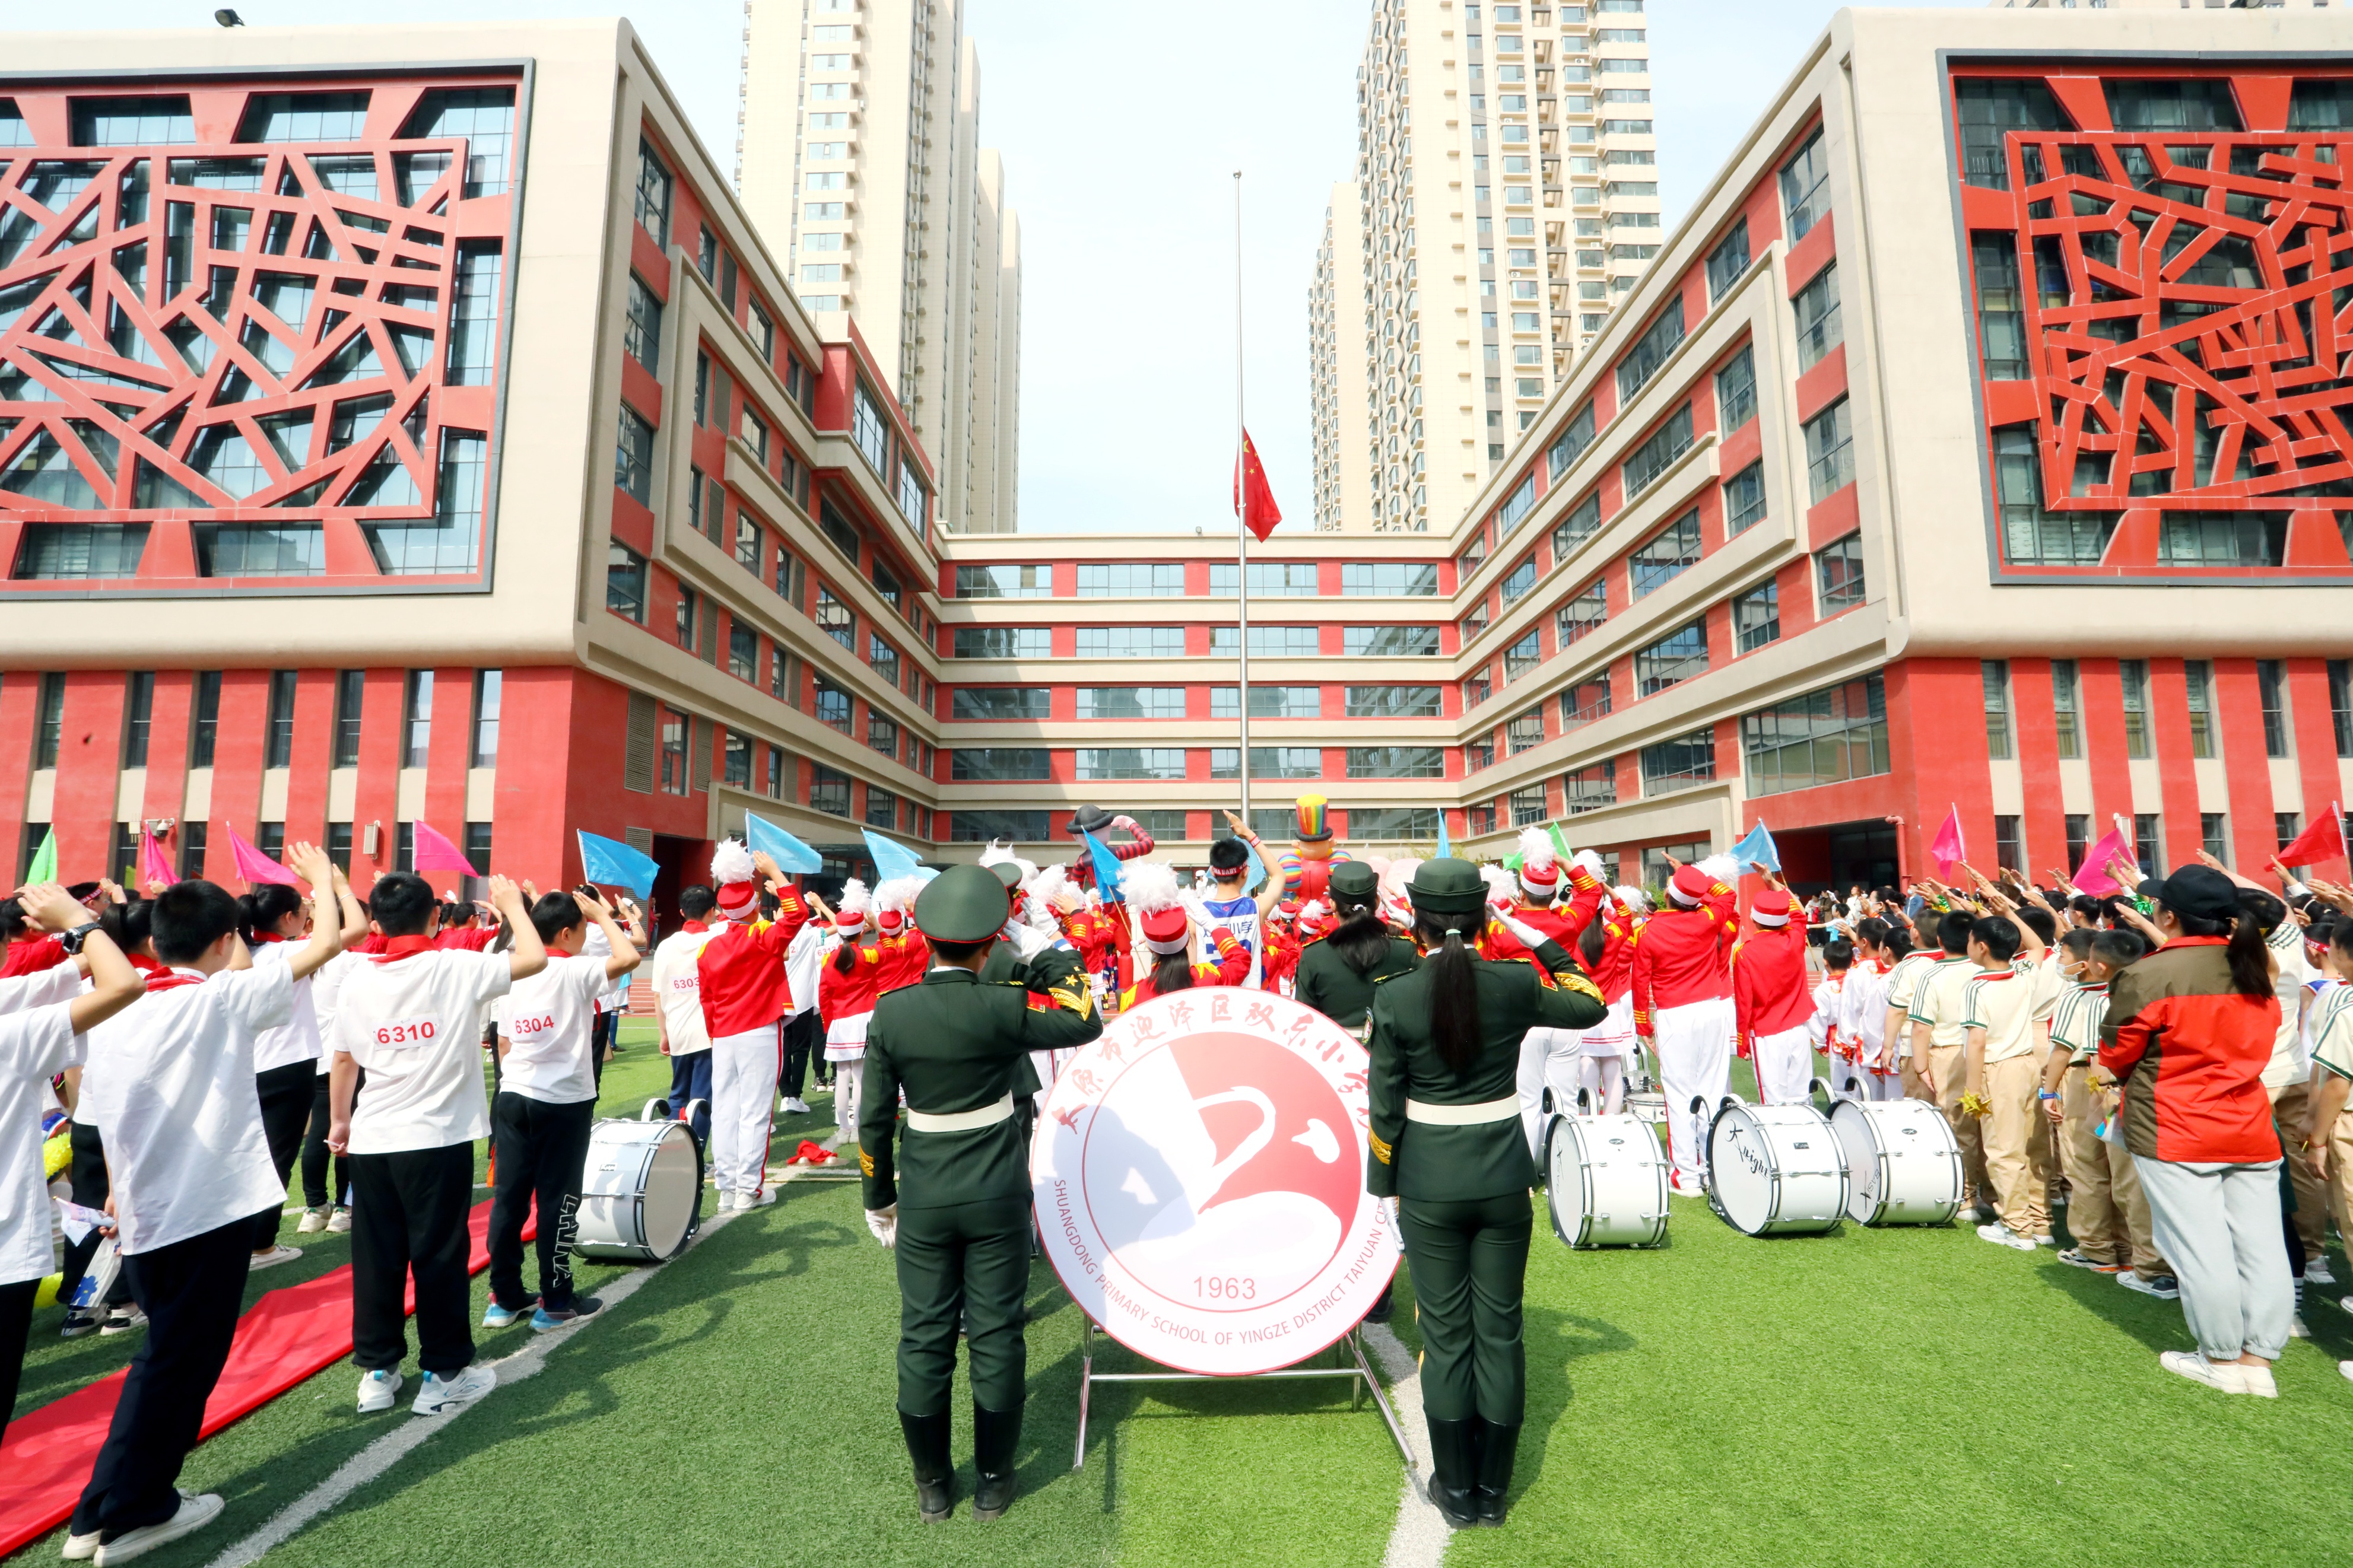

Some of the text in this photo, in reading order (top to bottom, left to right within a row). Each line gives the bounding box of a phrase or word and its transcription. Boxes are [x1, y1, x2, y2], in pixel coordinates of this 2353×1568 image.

[674, 977, 700, 990] 6303
[377, 1022, 435, 1044] 6310
[515, 1015, 554, 1034] 6304
[1054, 1179, 1387, 1345] SHUANGDONG PRIMARY SCHOOL OF YINGZE DISTRICT TAIYUAN CIT
[1193, 1276, 1256, 1300] 1963
